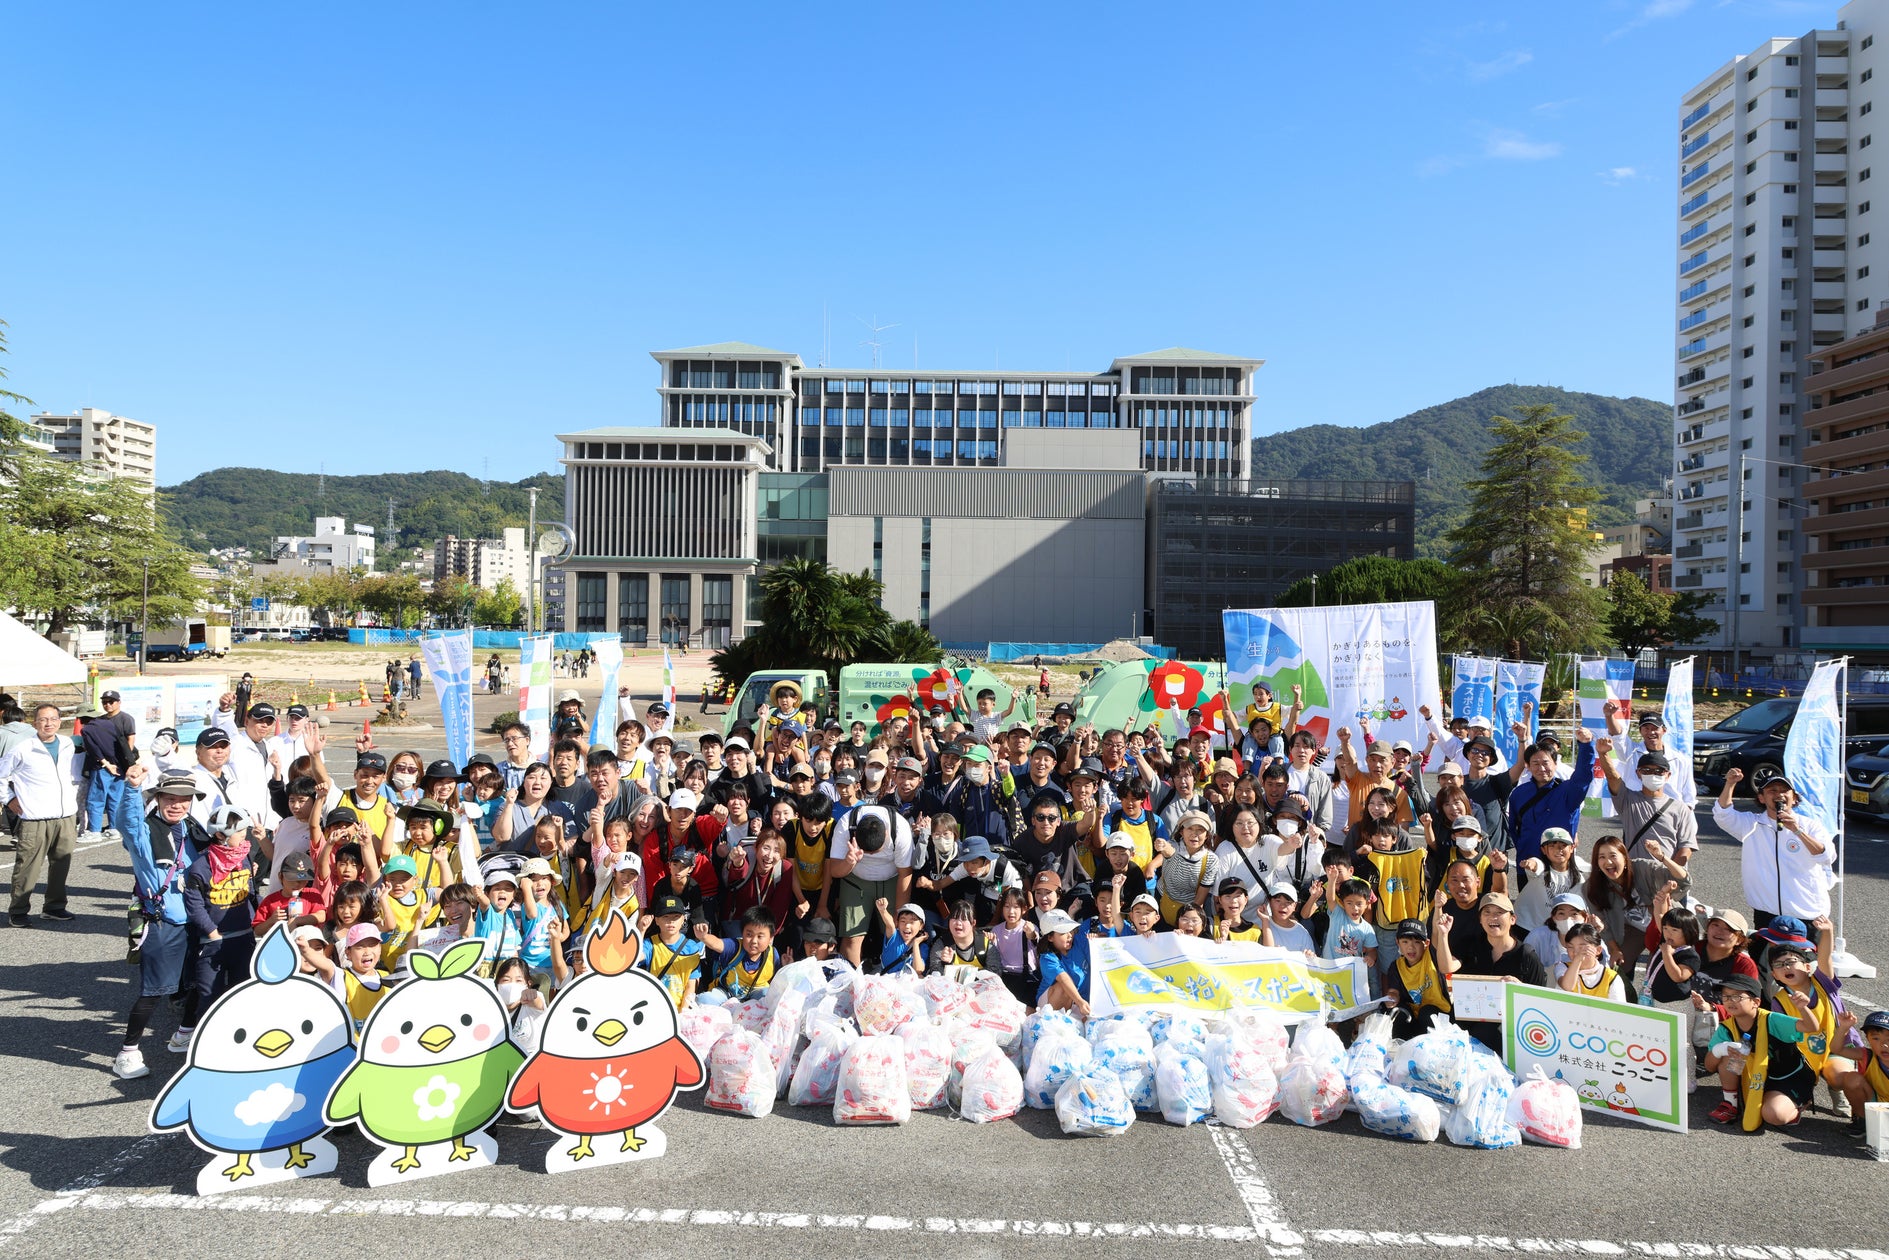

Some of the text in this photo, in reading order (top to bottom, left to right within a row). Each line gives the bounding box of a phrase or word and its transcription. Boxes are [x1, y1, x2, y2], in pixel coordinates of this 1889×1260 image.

[1333, 639, 1417, 651] かぎりあるものを、
[1333, 653, 1381, 663] かぎりなく
[624, 854, 636, 864] NY
[1258, 859, 1268, 873] LA
[1568, 1031, 1668, 1067] COCCO
[1558, 1053, 1669, 1083] 株式会社 こっこー
